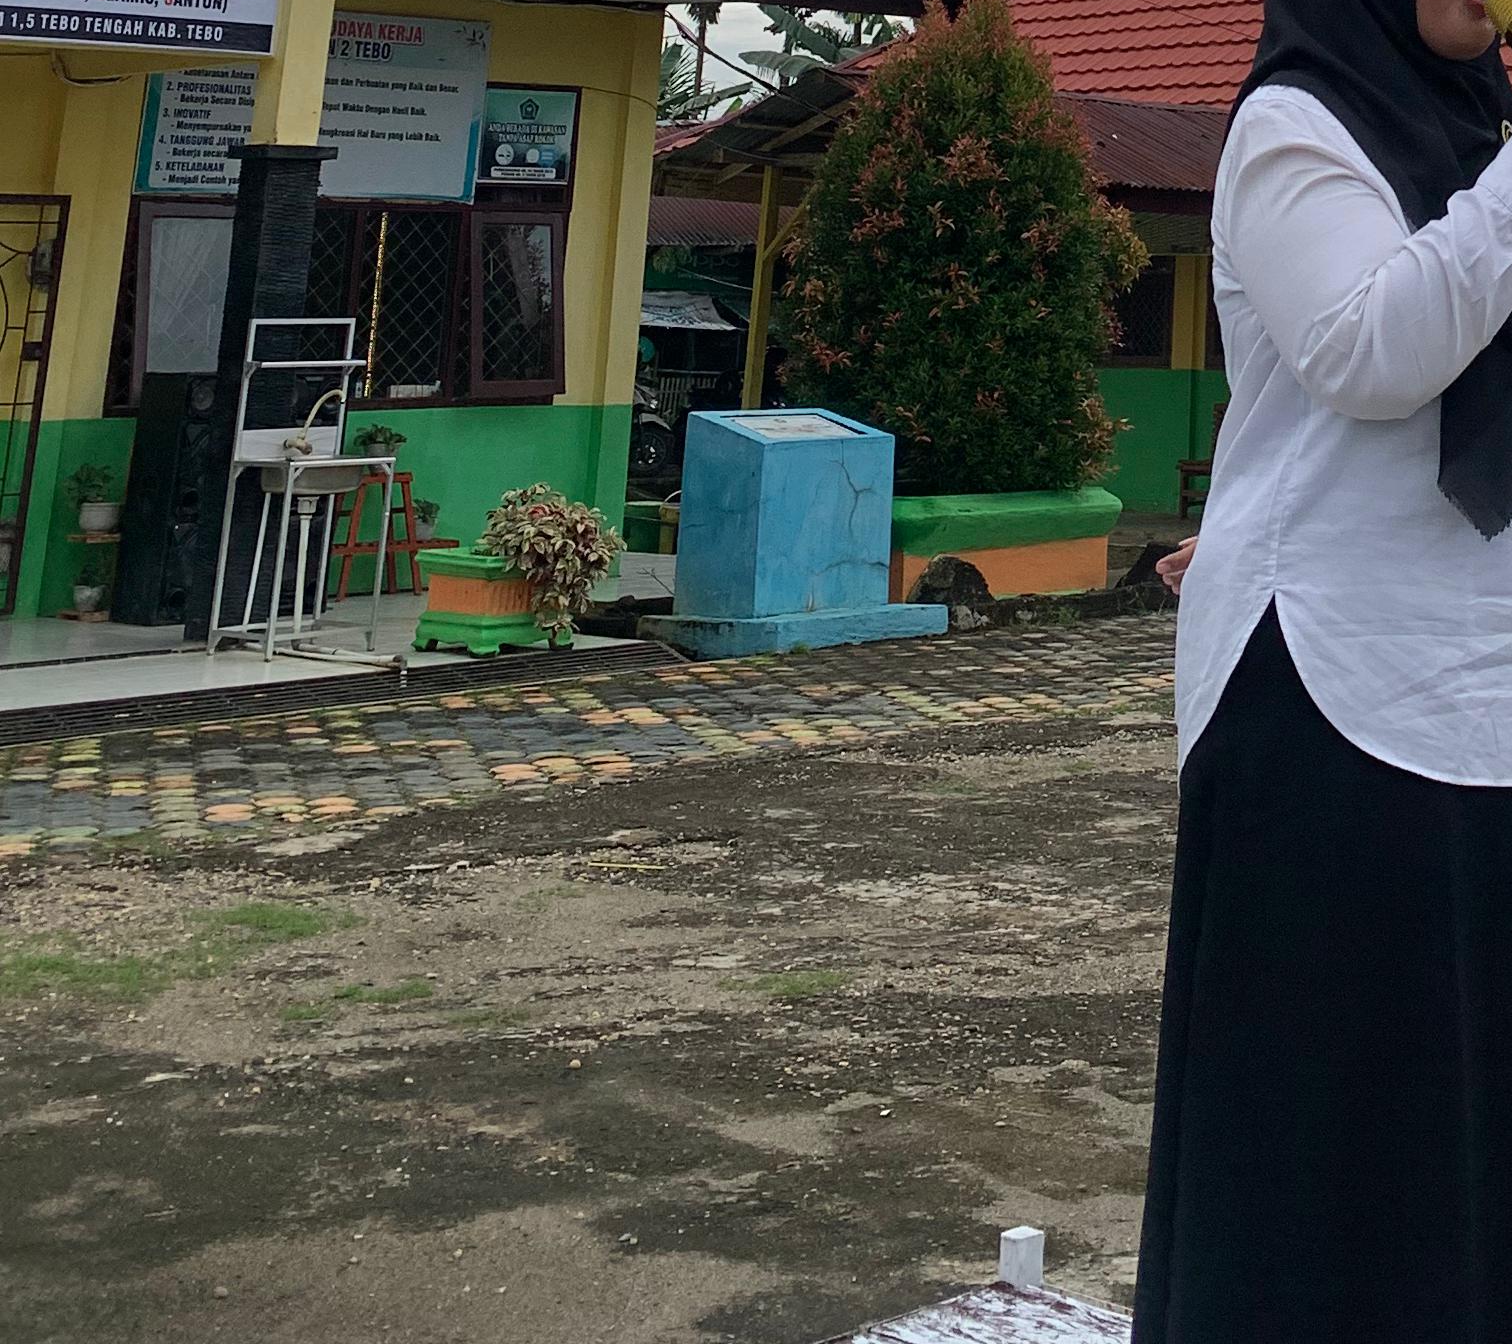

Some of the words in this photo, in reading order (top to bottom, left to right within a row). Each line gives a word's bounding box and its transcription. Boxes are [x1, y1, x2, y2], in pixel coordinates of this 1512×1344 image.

[11, 13, 35, 30] 1,5
[41, 14, 80, 31] TEBO
[85, 17, 143, 36] TENGAH
[148, 21, 181, 39] KAB.
[187, 25, 223, 42] TEBO
[378, 24, 422, 43] KERJA
[341, 40, 350, 57] 2
[355, 41, 391, 59] TEBO
[176, 81, 252, 95] PROFESIONALITAS
[173, 108, 212, 119] INOVATIF
[170, 135, 214, 146] TANGGUNG
